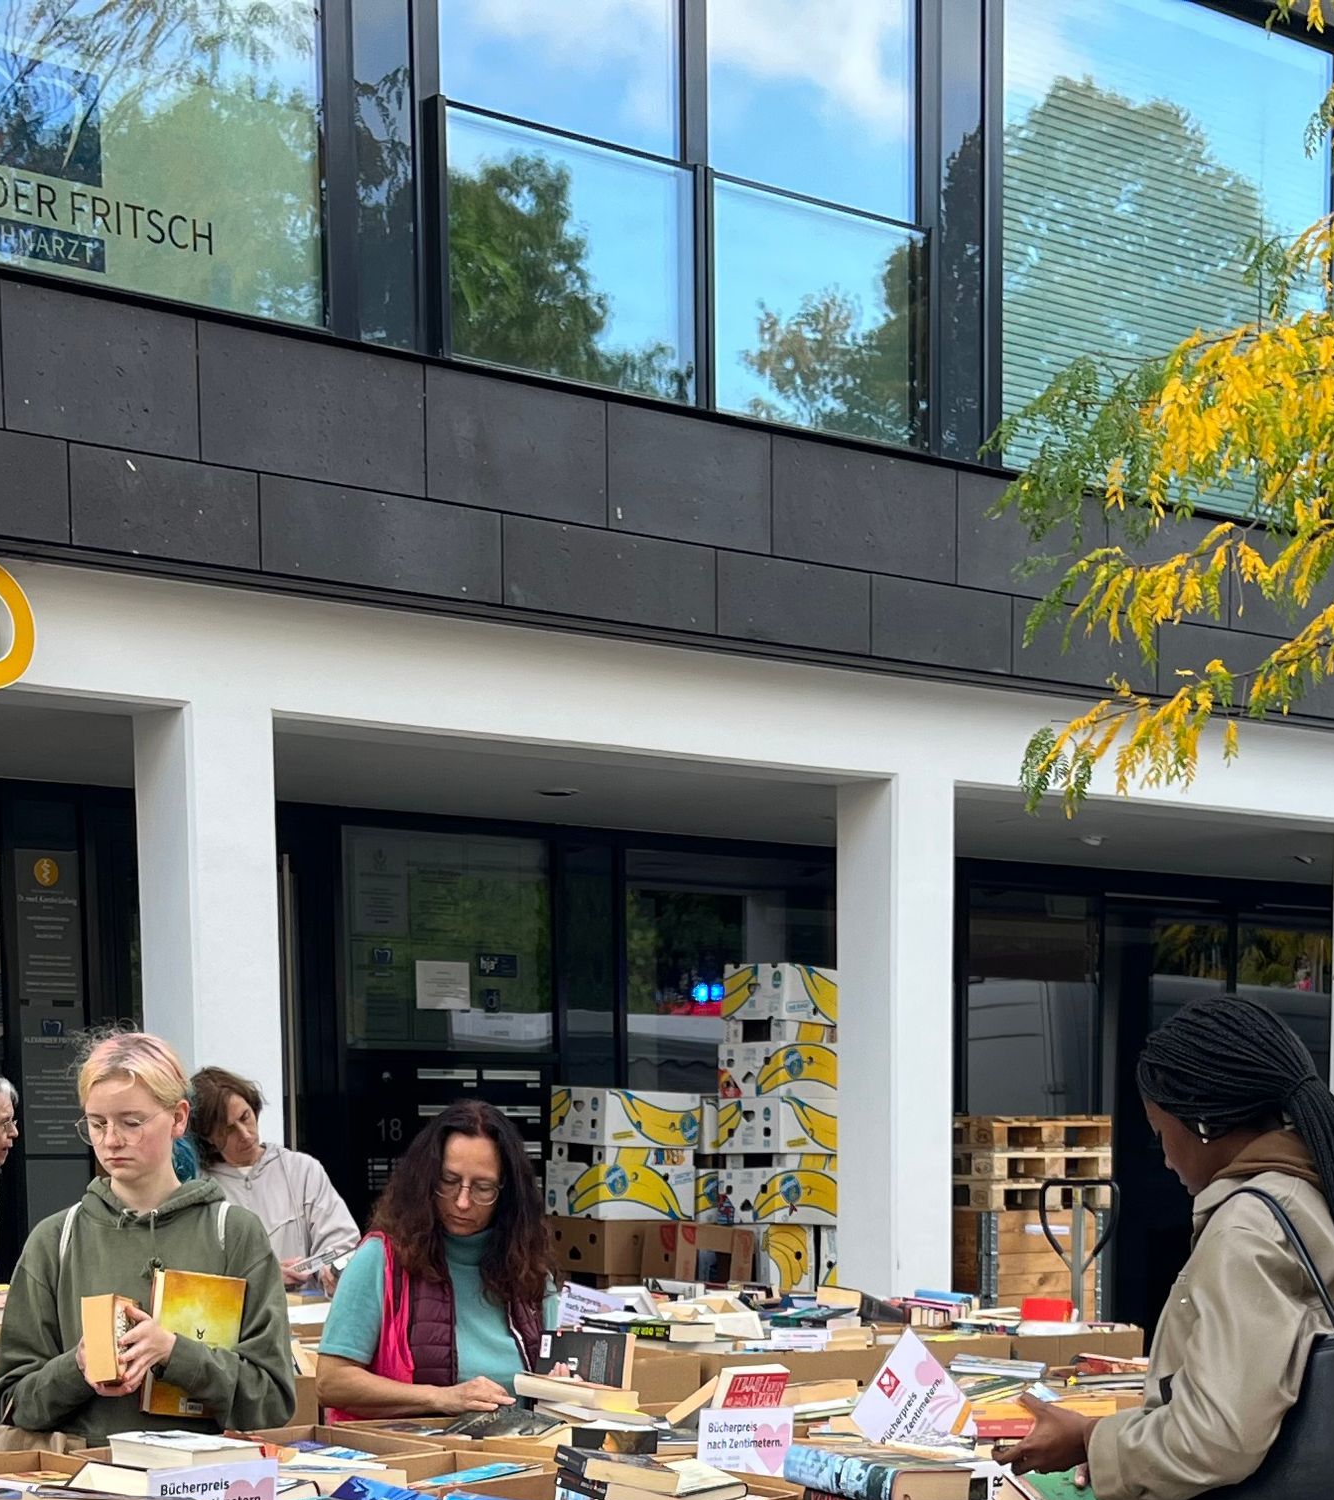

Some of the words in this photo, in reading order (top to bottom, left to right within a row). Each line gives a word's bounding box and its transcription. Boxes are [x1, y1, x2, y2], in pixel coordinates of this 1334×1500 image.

[71, 191, 214, 256] FRITSCH
[376, 1117, 403, 1142] 18
[708, 1420, 758, 1435] Bücherpreis
[707, 1439, 727, 1450] nach
[728, 1437, 783, 1450] Zentimetern.
[160, 1478, 230, 1497] Bücherpreis
